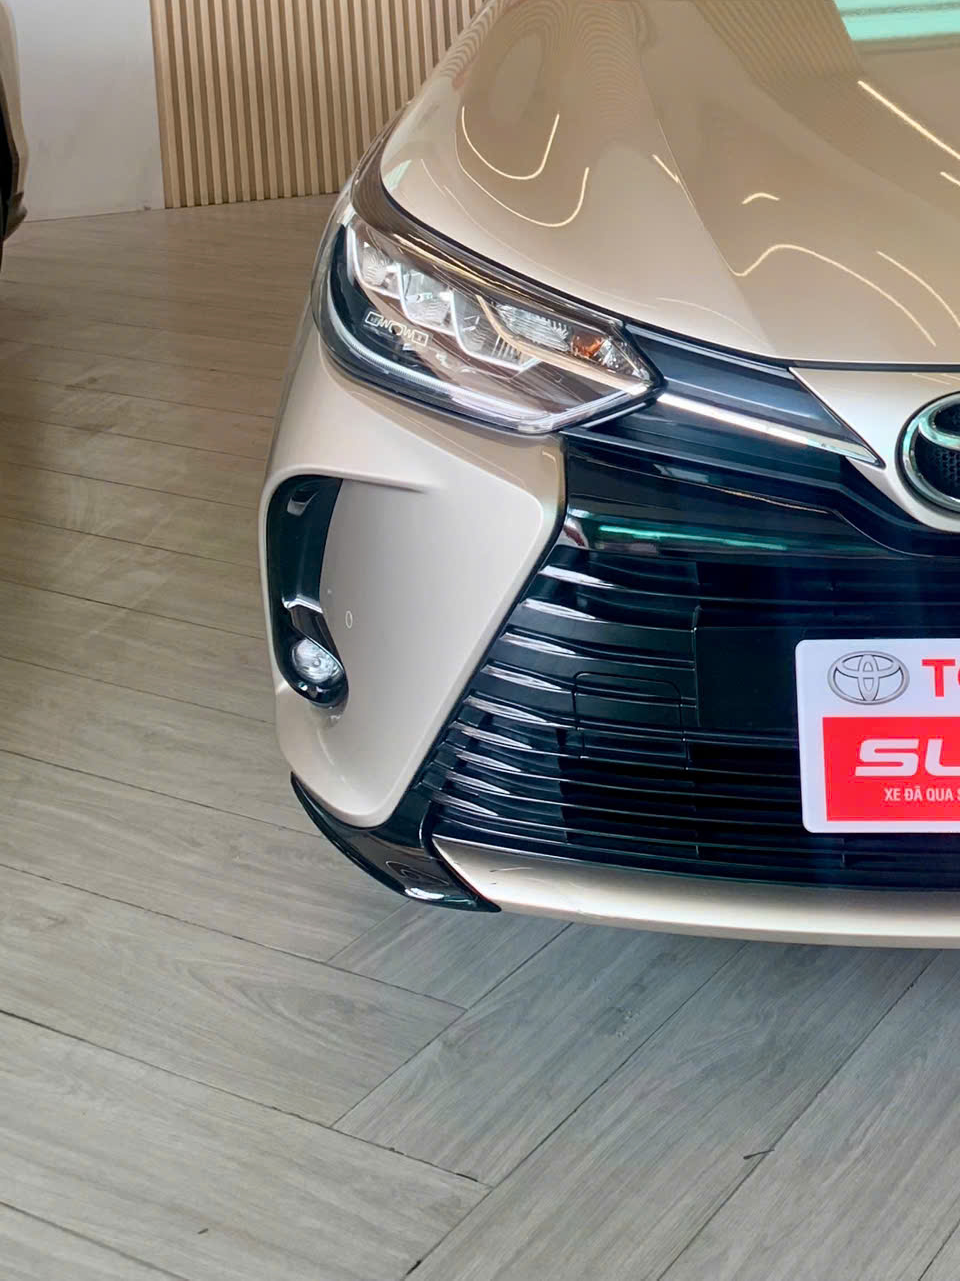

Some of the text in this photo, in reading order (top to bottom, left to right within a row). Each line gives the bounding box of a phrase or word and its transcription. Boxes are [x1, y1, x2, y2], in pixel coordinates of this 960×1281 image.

[884, 787, 901, 801] XE
[904, 785, 923, 801] ĐÃ
[926, 788, 954, 802] QUA
